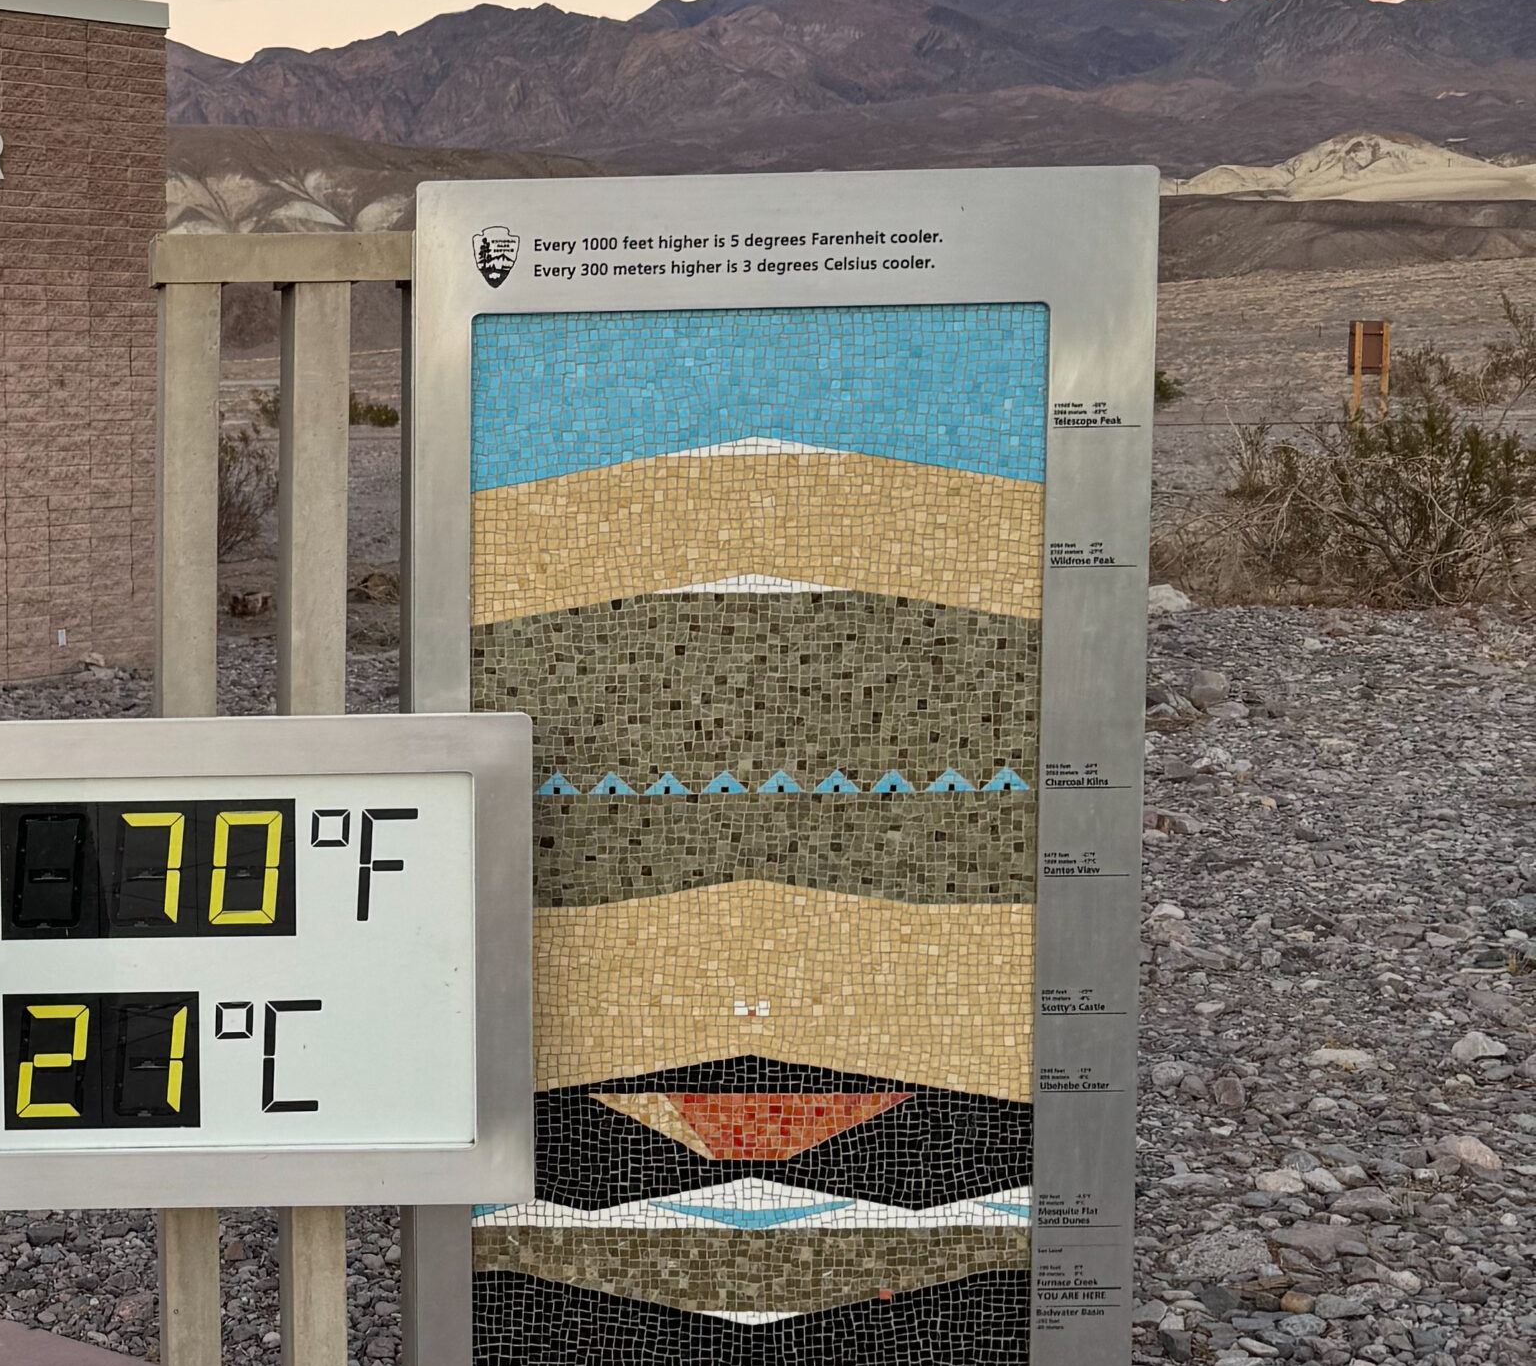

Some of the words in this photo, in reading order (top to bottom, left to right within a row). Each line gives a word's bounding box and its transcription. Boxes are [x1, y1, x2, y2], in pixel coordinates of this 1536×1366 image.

[534, 239, 576, 255] Every
[582, 237, 618, 250] 1000
[622, 236, 654, 250] feet
[658, 235, 709, 252] higher
[714, 234, 725, 248] is
[730, 234, 739, 248] 5
[744, 233, 806, 250] degrees
[811, 230, 886, 246] Farenheit
[890, 229, 943, 244] cooler.
[534, 264, 576, 280] Every
[580, 263, 608, 276] 300
[613, 261, 666, 276] meters
[671, 260, 722, 277] higher
[727, 260, 738, 273] is
[743, 260, 752, 273] 3
[757, 258, 819, 275] degrees
[824, 257, 877, 271] Celsius
[882, 255, 935, 270] cooler.
[1100, 416, 1122, 425] Peak
[1050, 556, 1091, 565] Wildrose
[1094, 556, 1115, 564] Peak
[1045, 777, 1084, 786] Charcoal
[1087, 777, 1109, 786] Kilns
[1041, 1003, 1076, 1013] Scotty's
[1079, 1003, 1105, 1011] Castle
[1040, 1081, 1080, 1090] Ubehebe
[1082, 1081, 1109, 1090] Crater
[1038, 1207, 1079, 1217] Mesquite
[1082, 1207, 1098, 1215] Flat
[1038, 1217, 1060, 1225] Sand
[1037, 1278, 1071, 1287] Furnace
[1074, 1278, 1098, 1286] Creek
[1037, 1292, 1058, 1300] YOU
[1061, 1291, 1079, 1300] ARE
[1082, 1291, 1106, 1300] HERE
[1036, 1308, 1079, 1317] Badwater
[1081, 1308, 1105, 1316] Basin
